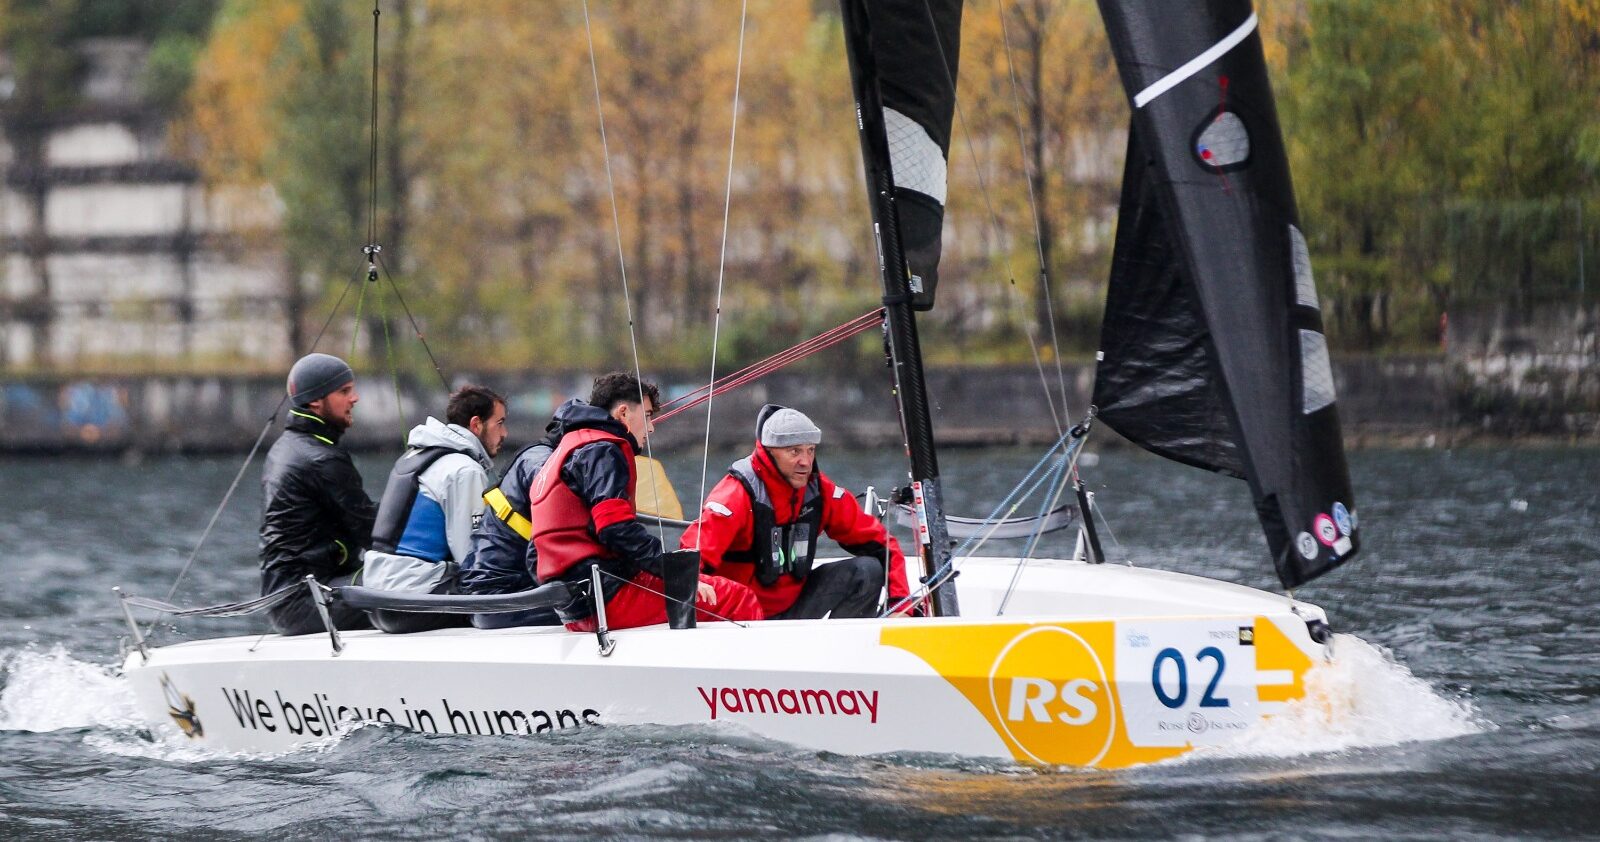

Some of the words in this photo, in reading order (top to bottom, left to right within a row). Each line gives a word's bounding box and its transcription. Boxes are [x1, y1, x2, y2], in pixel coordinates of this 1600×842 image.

[1008, 676, 1099, 726] RS
[1152, 646, 1230, 709] 02
[221, 687, 277, 732] We
[400, 697, 438, 734] in
[697, 686, 879, 723] yamamay
